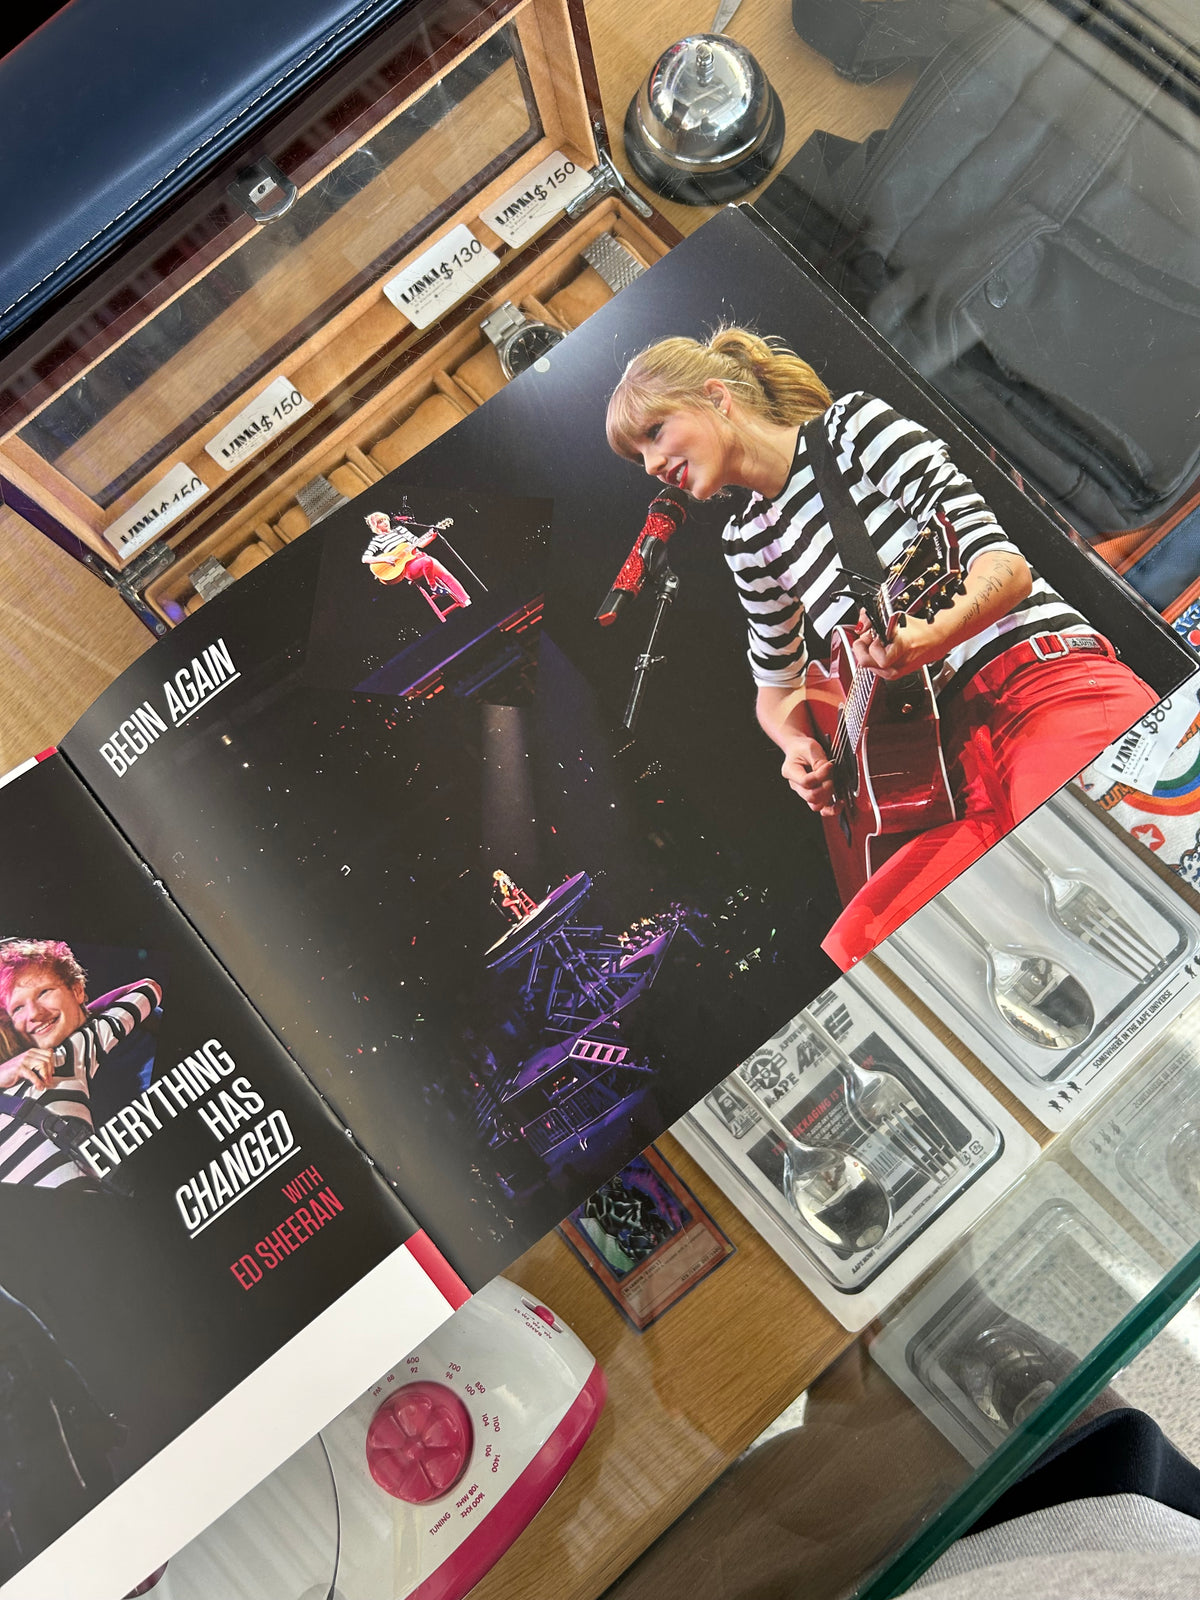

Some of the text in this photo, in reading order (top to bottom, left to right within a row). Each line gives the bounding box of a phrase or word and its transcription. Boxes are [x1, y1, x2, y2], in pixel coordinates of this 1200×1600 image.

[534, 161, 576, 201] $150
[440, 240, 482, 280] $130
[260, 391, 302, 432] $150
[99, 637, 237, 779] BEGIN AGAIN
[1141, 697, 1173, 735] $80
[1093, 989, 1173, 1069] SOMEWHERE IN THE AAPE UNIVERSE
[761, 1071, 800, 1108] AAPE
[78, 1037, 237, 1179] EVERYTHING
[197, 1075, 267, 1143] HAS
[175, 1108, 296, 1231] CHANGED
[282, 1164, 324, 1206] WITH
[229, 1185, 345, 1292] ED SHEERAN
[406, 1356, 420, 1364] 600
[448, 1362, 461, 1372] 700
[387, 1374, 395, 1382] 88
[445, 1372, 454, 1380] 96
[464, 1384, 476, 1396] 100
[474, 1382, 486, 1394] 850
[373, 1386, 382, 1397] FM
[481, 1413, 490, 1427] 104
[492, 1454, 501, 1473] 1400
[468, 1483, 479, 1497] 108
[472, 1492, 485, 1508] 1600
[429, 1512, 451, 1536] TUNING
